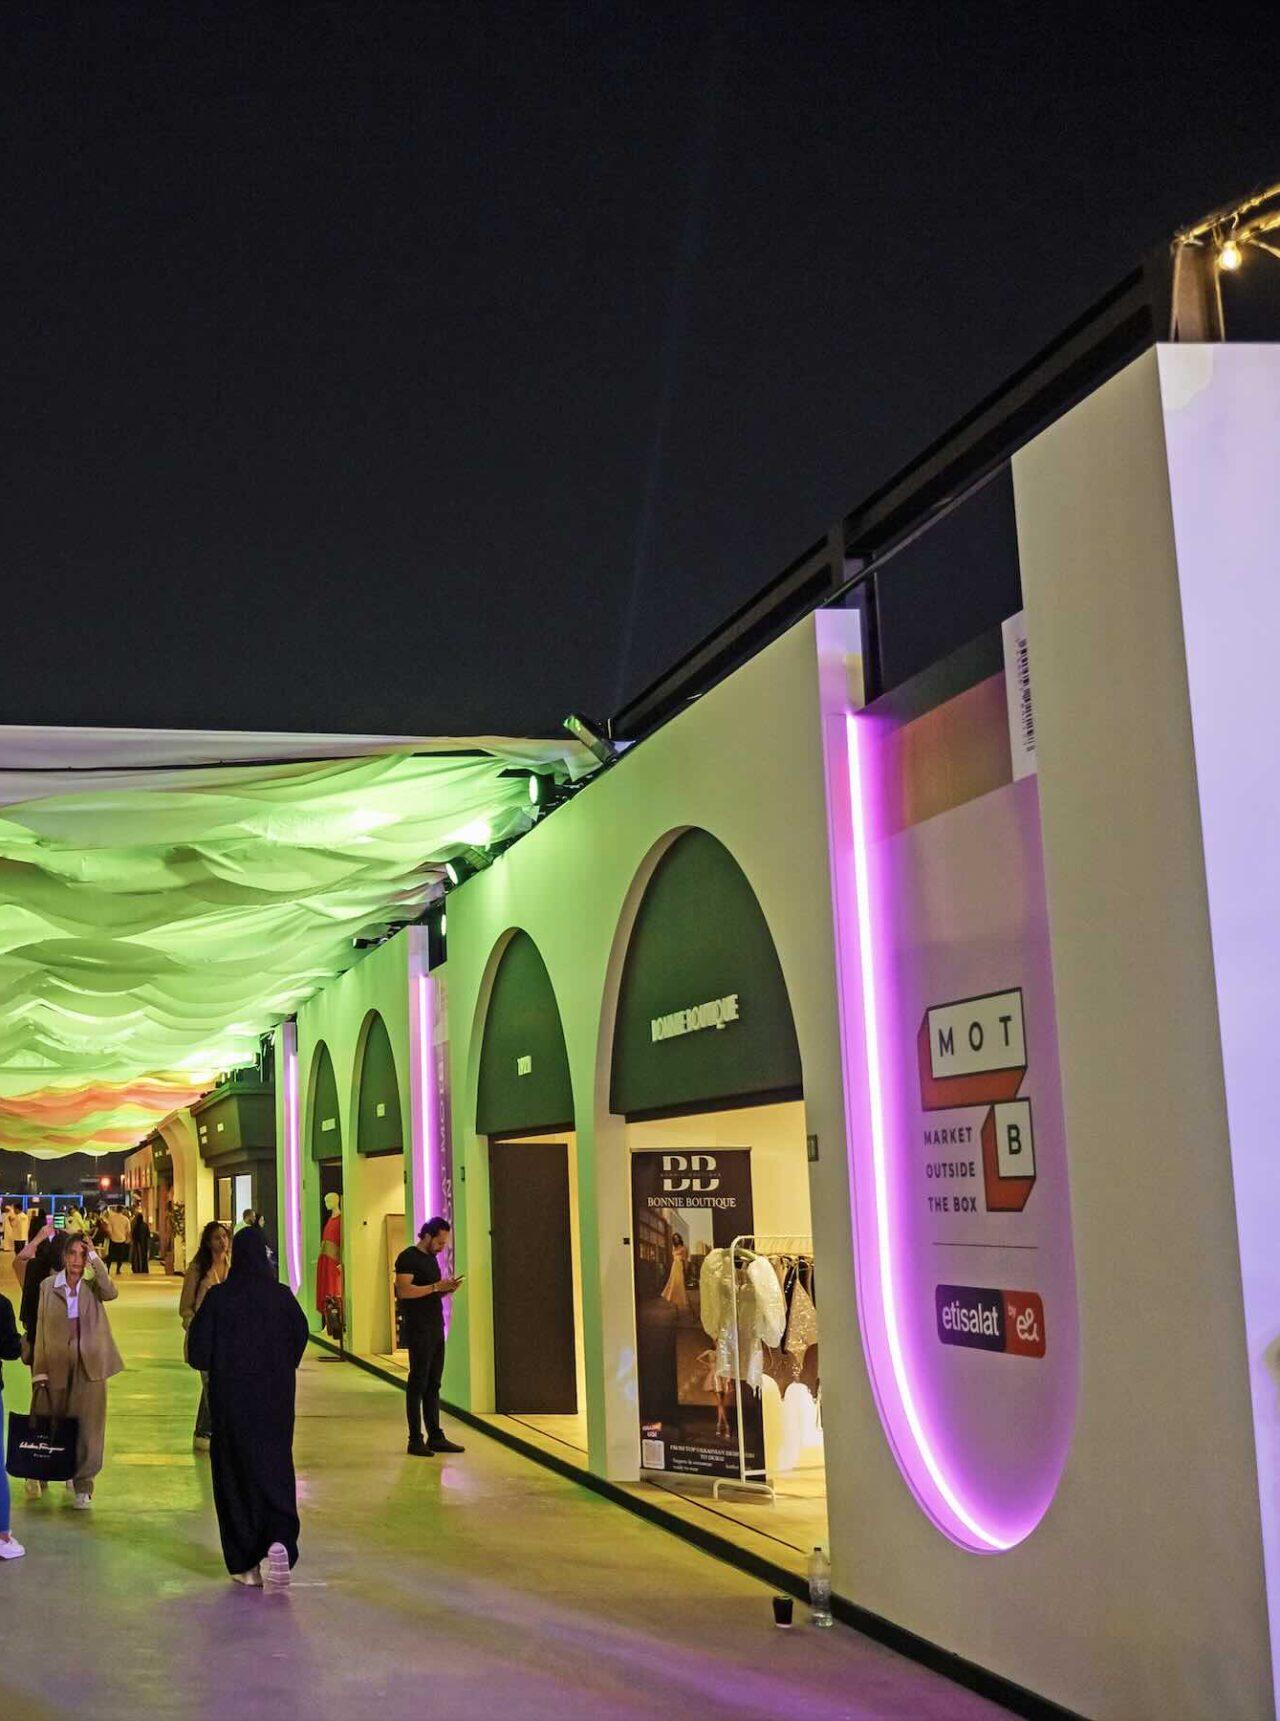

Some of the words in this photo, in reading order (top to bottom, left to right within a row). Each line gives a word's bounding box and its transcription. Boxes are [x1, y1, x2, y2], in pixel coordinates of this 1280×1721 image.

[937, 1014, 1013, 1057] MOT
[923, 1126, 972, 1146] MARKET
[1006, 1123, 1023, 1155] B
[926, 1161, 976, 1179] OUTSIDE
[648, 1197, 685, 1208] BONNIE
[686, 1197, 737, 1210] BOUTIQUE
[927, 1196, 950, 1212] THE
[953, 1195, 977, 1213] BOX
[942, 1301, 1000, 1337] etisalat
